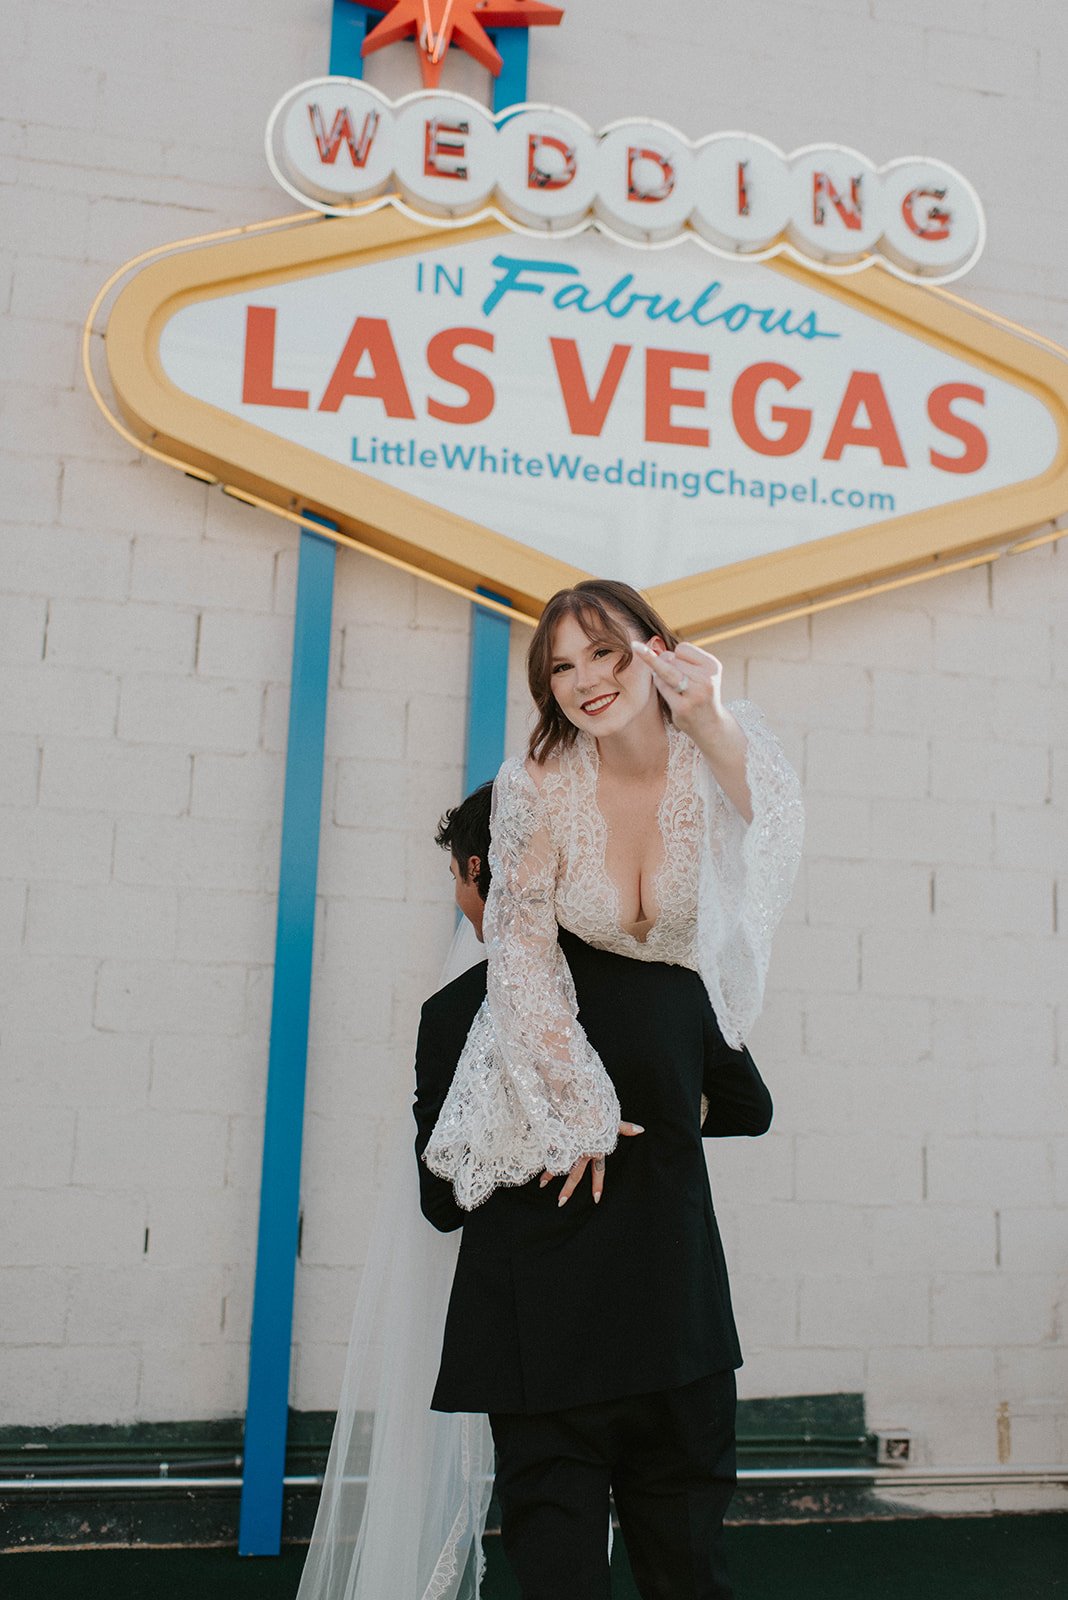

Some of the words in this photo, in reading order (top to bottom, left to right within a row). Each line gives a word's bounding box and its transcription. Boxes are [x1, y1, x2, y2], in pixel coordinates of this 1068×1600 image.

[308, 104, 950, 241] WEDDING
[416, 262, 464, 296] IN
[481, 254, 841, 340] Fabulous
[241, 305, 496, 424] LAS
[548, 336, 990, 475] VEGAS
[350, 436, 896, 512] LittleWhiteWeddingChapel.com
